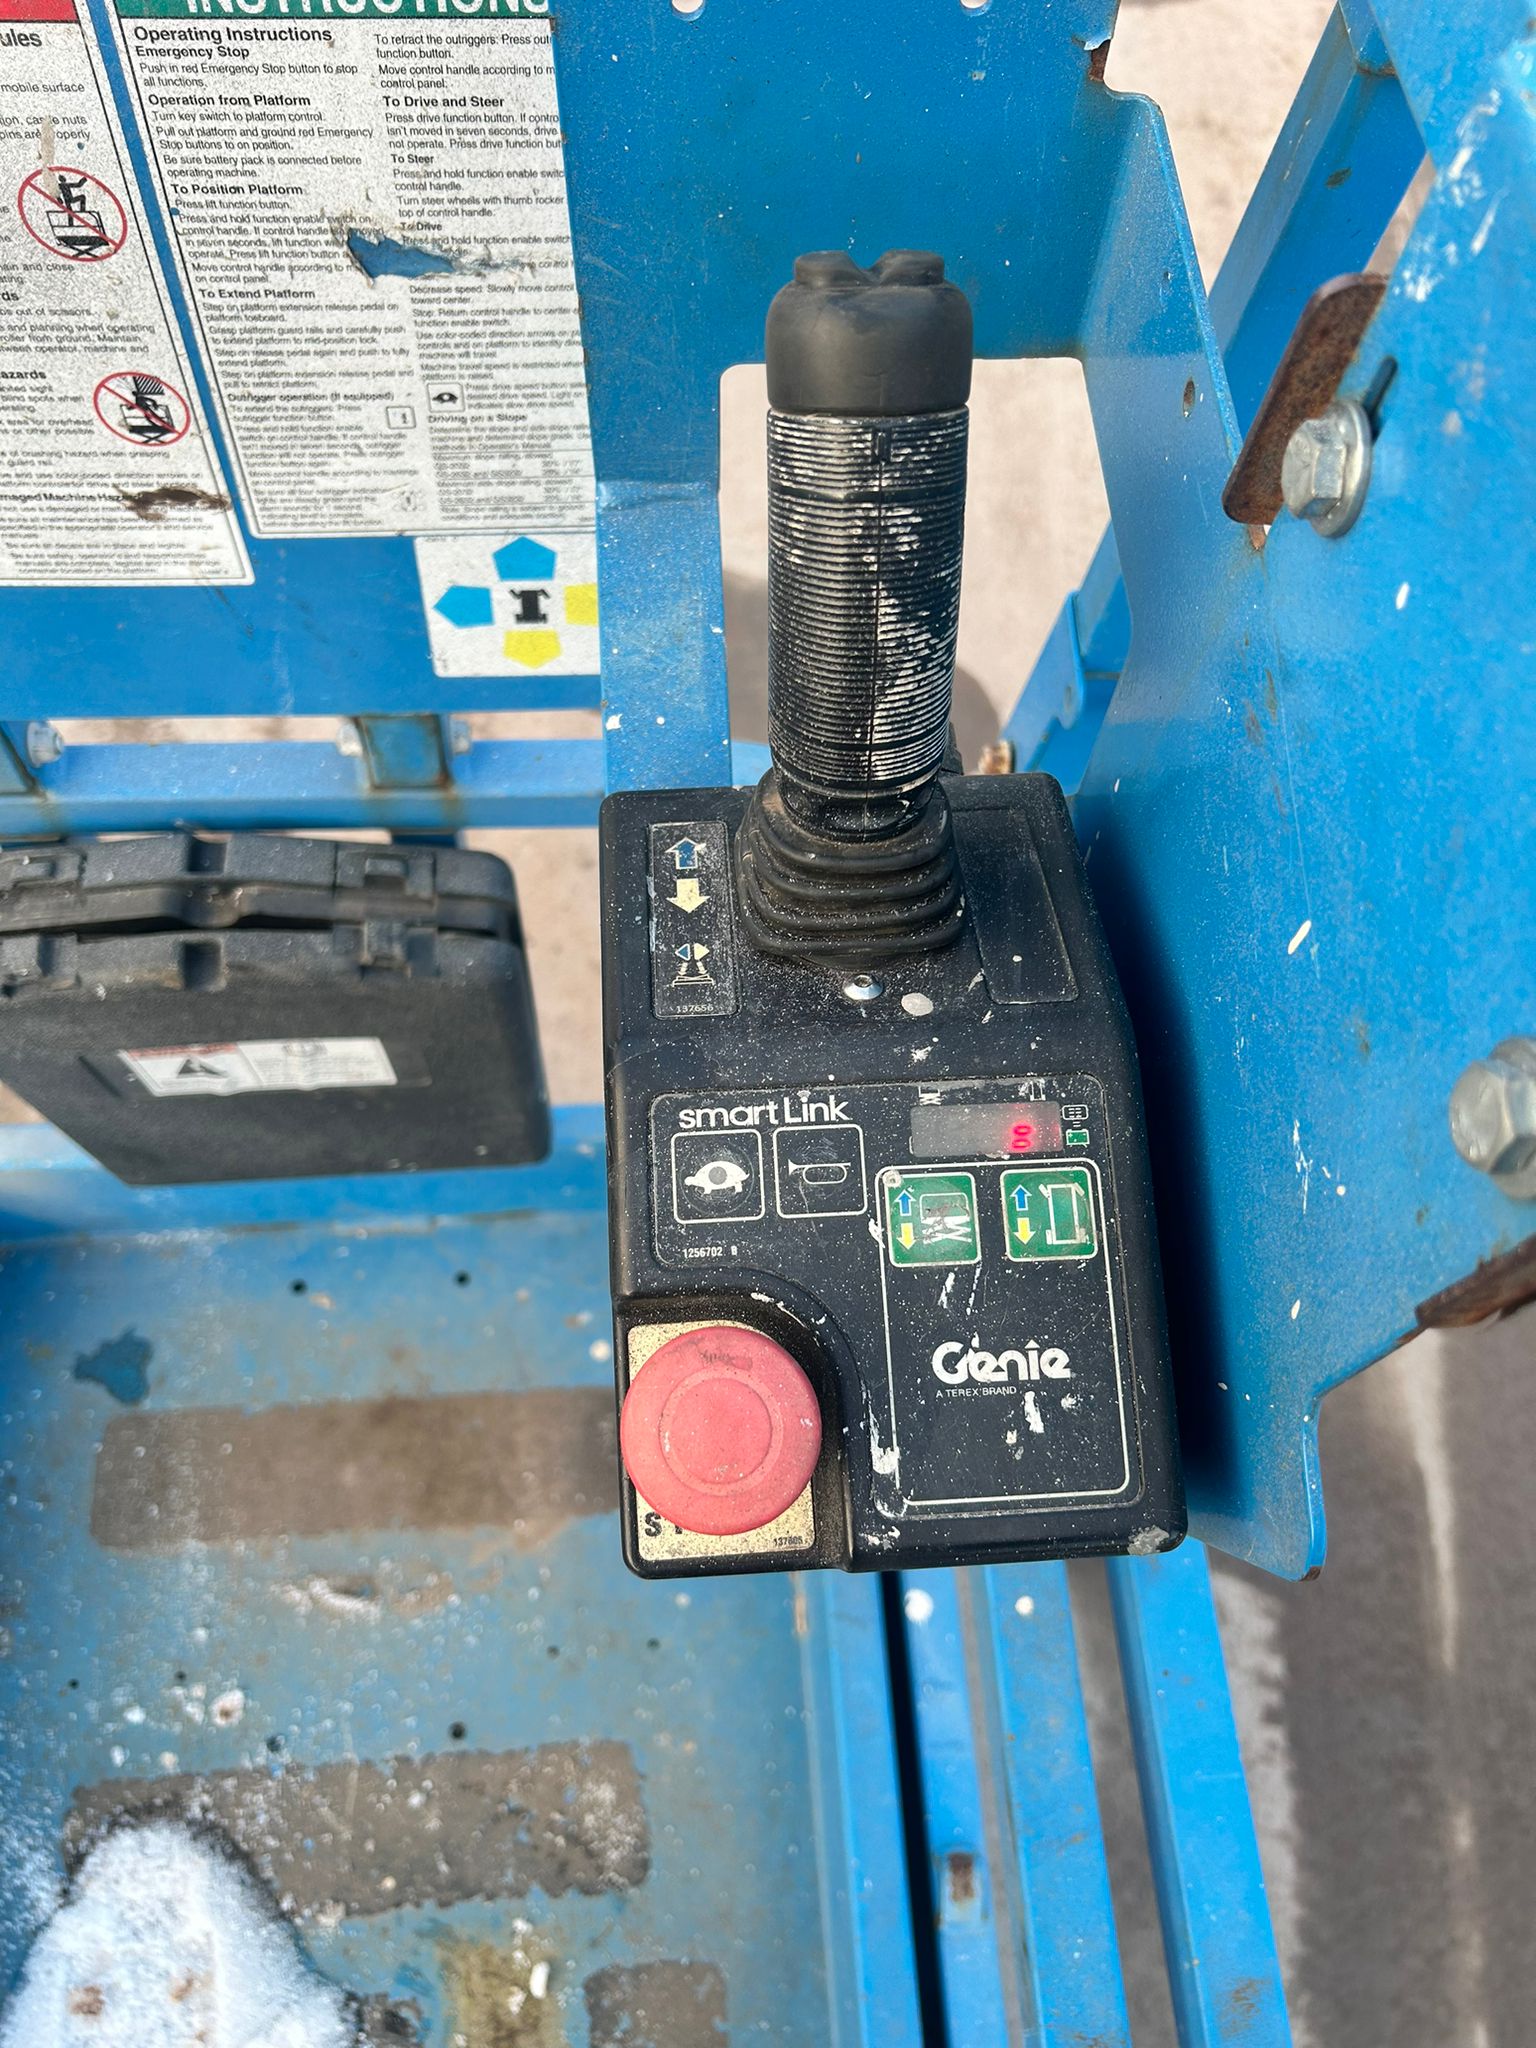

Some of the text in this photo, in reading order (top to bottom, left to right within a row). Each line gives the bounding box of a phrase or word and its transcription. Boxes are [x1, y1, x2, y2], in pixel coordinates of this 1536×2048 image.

[134, 26, 333, 45] Operating Instructions
[391, 34, 424, 45] retract
[426, 34, 443, 45] the
[501, 34, 531, 45] Press
[135, 46, 250, 60] Emergency Stop
[376, 49, 417, 59] function
[139, 63, 167, 74] Push
[182, 63, 199, 74] red
[201, 63, 260, 76] Emergency
[262, 63, 286, 76] Stop
[288, 63, 322, 74] button
[335, 63, 358, 76] stop
[378, 65, 407, 75] Move
[409, 65, 444, 75] control
[446, 65, 480, 75] handle
[482, 65, 531, 78] according
[42, 82, 85, 93] surface
[143, 77, 156, 88] all
[380, 78, 415, 88] control
[148, 94, 311, 109] Operation from Platform
[382, 96, 505, 107] To Drive and Steer
[62, 115, 88, 125] nuts
[152, 111, 176, 122] Turn
[178, 111, 197, 124] key
[199, 111, 231, 122] switch
[245, 111, 286, 124] platform
[385, 113, 414, 123] Press
[416, 113, 441, 123] drive
[442, 113, 482, 123] function
[56, 130, 91, 141] operly
[156, 127, 373, 140] Pull out platform and ground red Emergency
[386, 126, 408, 136] isn't
[409, 126, 443, 136] moved
[456, 128, 486, 136] seven
[534, 126, 558, 136] drive
[160, 140, 183, 152] Stop
[185, 140, 222, 150] buttons
[388, 139, 404, 149] not
[450, 139, 479, 149] Press
[480, 139, 504, 149] drive
[505, 139, 544, 149] function
[180, 157, 202, 165] sure
[204, 155, 238, 167] battery
[240, 155, 265, 167] pack
[278, 155, 329, 165] connected
[330, 155, 362, 165] before
[390, 154, 435, 164] To Steer
[167, 168, 213, 180] operating
[424, 169, 442, 179] and
[444, 169, 465, 179] hold
[466, 169, 504, 179] function
[506, 169, 539, 179] enable
[170, 184, 304, 195] To Position Platform
[394, 182, 427, 191] control
[174, 199, 202, 209] Press
[205, 199, 217, 209] lift
[219, 199, 257, 209] function
[397, 196, 565, 205] Turn steer wheels with thumb rocker
[398, 209, 414, 219] top
[427, 209, 460, 217] control
[416, 222, 443, 231] Drive
[198, 289, 316, 299] To Extend Platform
[676, 1004, 714, 1013] 137656
[682, 1246, 723, 1259] 1256702
[932, 1339, 1073, 1384] Genie
[936, 1386, 1017, 1398] A TEREX BRAND
